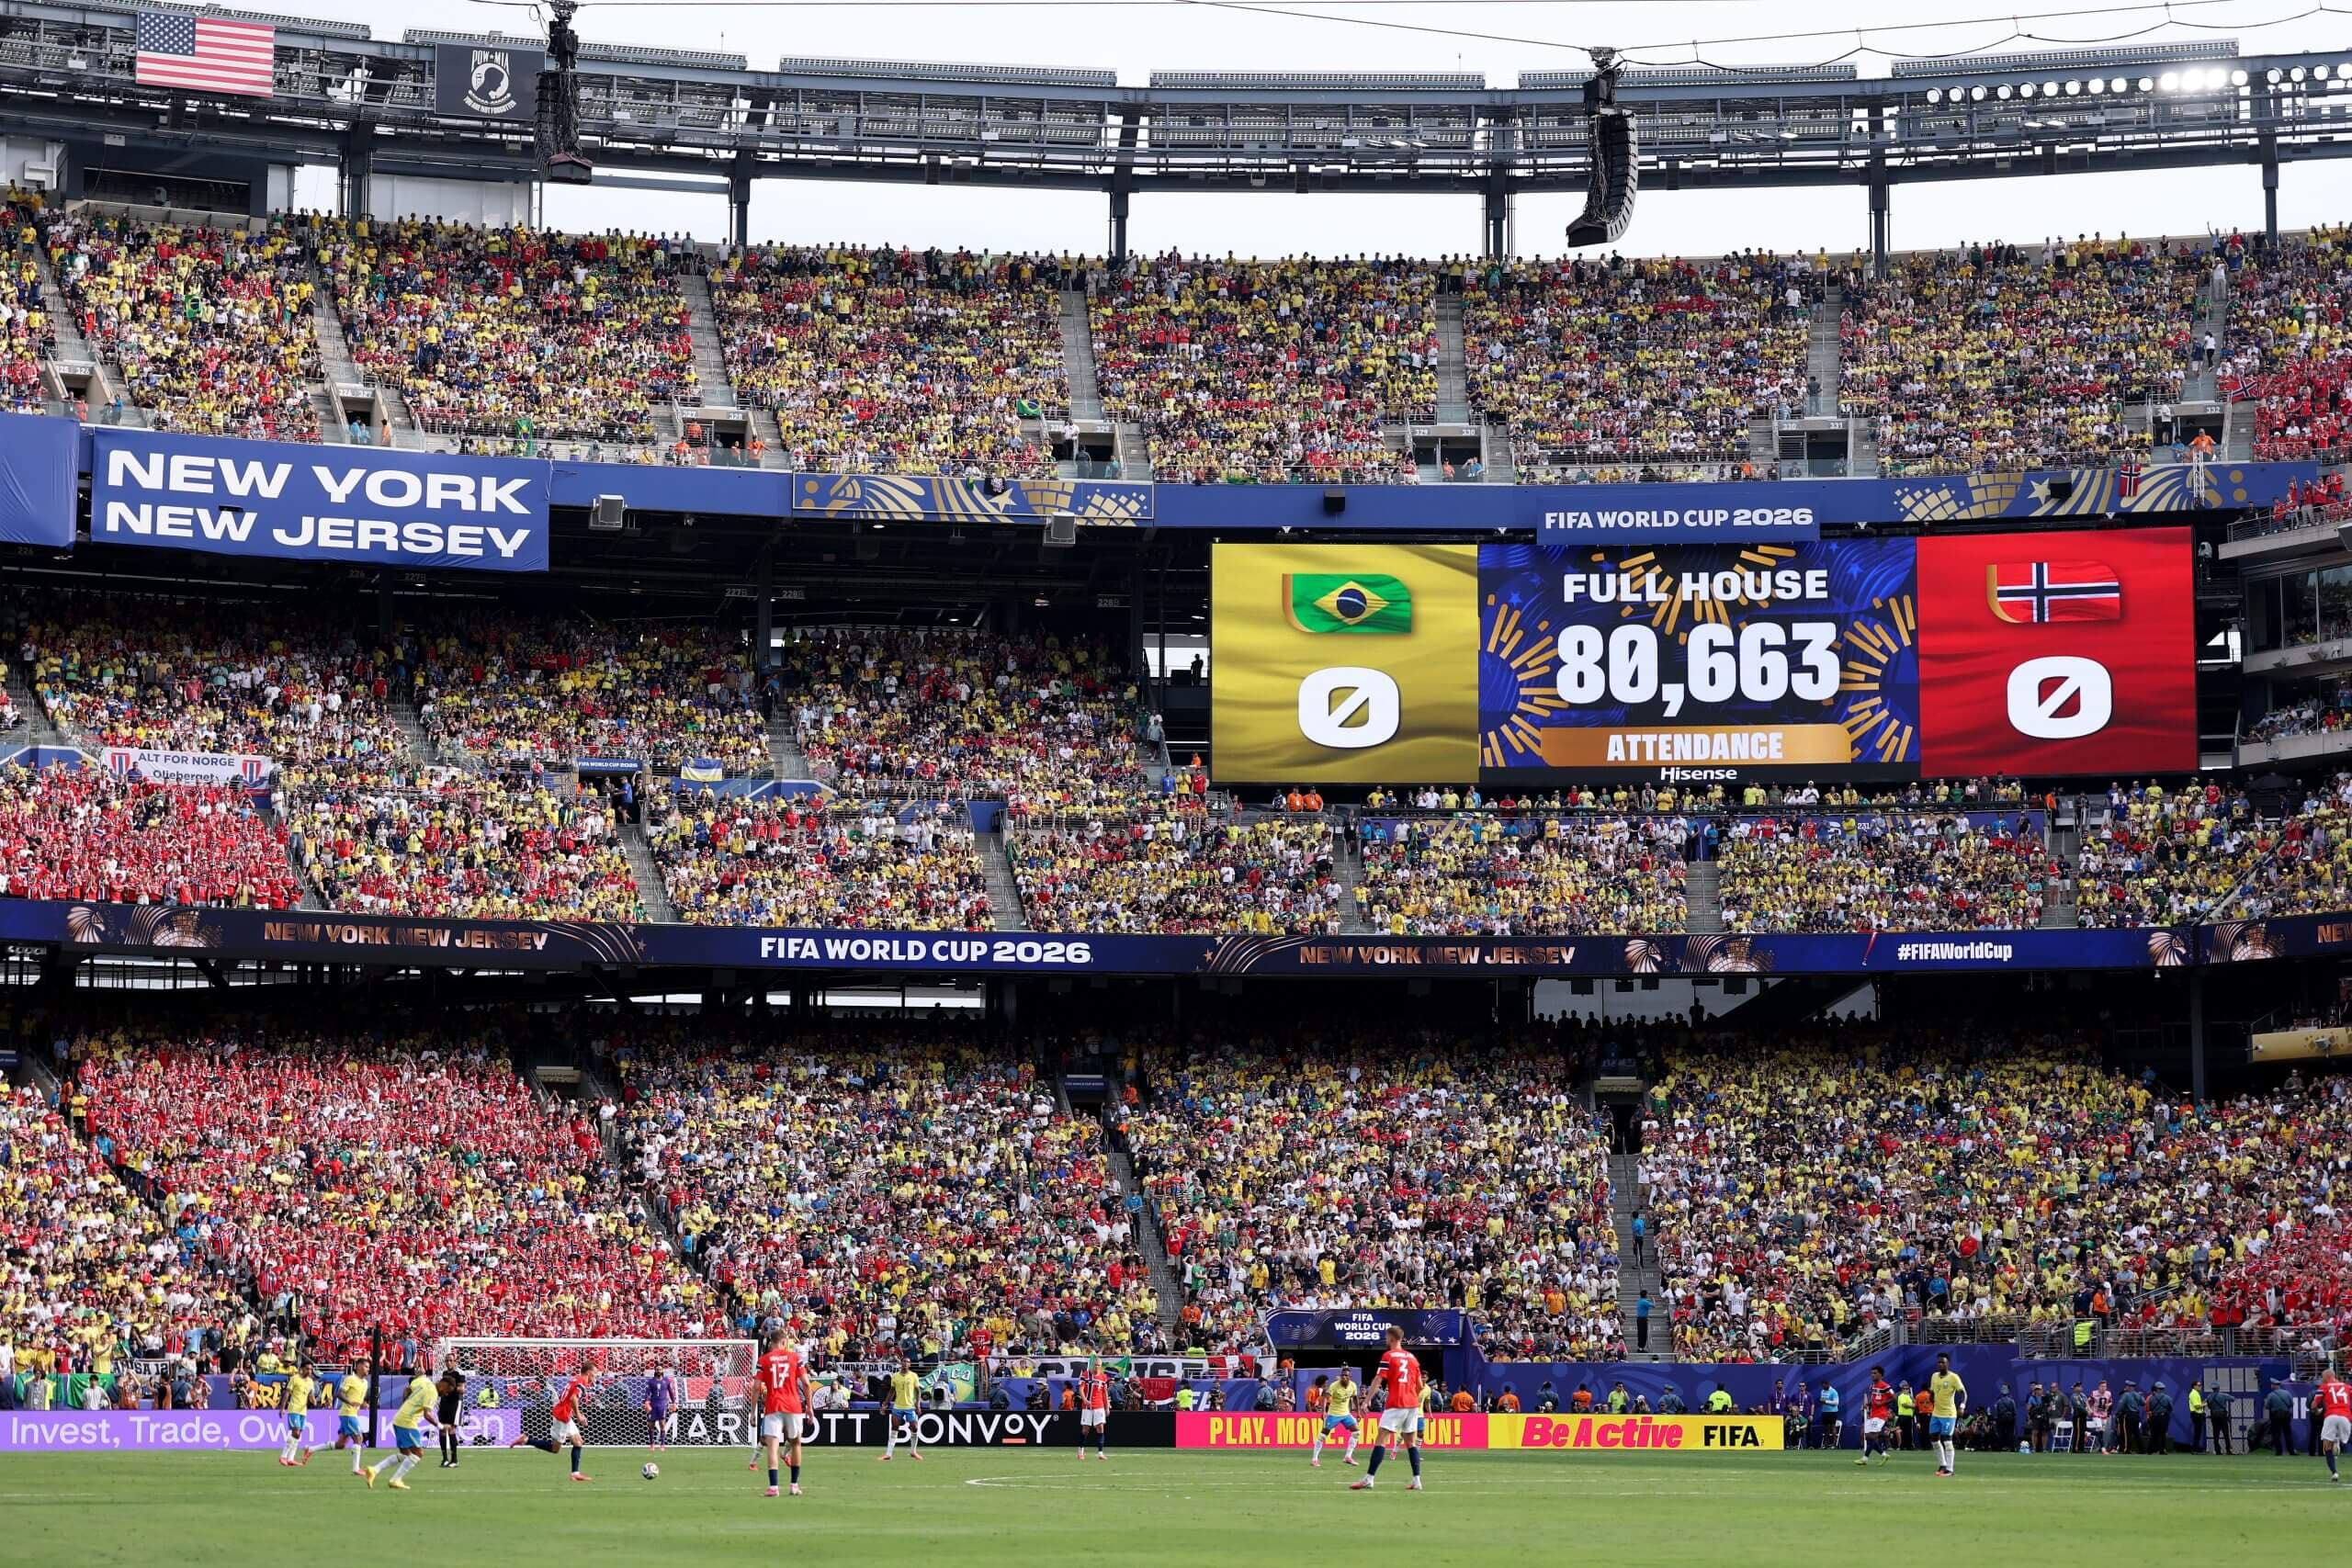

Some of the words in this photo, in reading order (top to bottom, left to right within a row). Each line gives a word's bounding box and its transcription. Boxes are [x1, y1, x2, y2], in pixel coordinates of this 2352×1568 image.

[471, 51, 490, 72] POW
[494, 51, 510, 75] MIA
[108, 450, 292, 498] NEW
[311, 466, 532, 514] YORK
[106, 502, 257, 541] NEW
[273, 516, 531, 558] JERSEY
[1545, 512, 1594, 529] FIFA
[1598, 511, 1679, 528] WORLD
[1683, 509, 1728, 527] CUP
[1733, 509, 1813, 525] 2026
[1564, 573, 1668, 603] FULL
[1681, 570, 1828, 601] HOUSE
[1556, 622, 1840, 717] 80,663
[1298, 666, 1400, 749] 0
[2007, 656, 2113, 739] 0
[139, 752, 161, 763] ALT
[164, 754, 188, 764] FOR
[193, 756, 235, 767] NORGE
[1607, 732, 1783, 761] ATTENDANCE
[1660, 767, 1737, 781] Hisense
[264, 922, 321, 942] NEW
[325, 925, 390, 944] YORK
[396, 928, 450, 947] NEW
[456, 931, 548, 950] JERSEY
[761, 937, 820, 959] FIFA
[825, 939, 926, 961] WORLD
[932, 940, 988, 962] CUP
[992, 942, 1091, 963] 2026
[1300, 946, 1353, 964] NEW
[1359, 946, 1422, 964] YORK
[1427, 946, 1480, 964] NEW
[1485, 946, 1576, 964] JERSEY
[1897, 942, 2012, 962] #FIFAWorldCup
[1334, 1323, 1371, 1331] WORLD
[1373, 1323, 1392, 1331] CUP
[1352, 1314, 1374, 1322] FIFA
[1345, 1332, 1380, 1340] 2026
[770, 1363, 790, 1389] 17
[1397, 1359, 1408, 1382] 3
[2329, 1386, 2347, 1404] 14
[12, 1417, 120, 1448] Invest,
[130, 1416, 230, 1447] Trade,
[654, 1413, 869, 1444] MAROTT
[1209, 1417, 1271, 1445] PLAY.
[1425, 1418, 1462, 1445] UN!
[1521, 1417, 1569, 1447] Be
[1573, 1416, 1683, 1448] Active
[1703, 1426, 1759, 1447] FIFA
